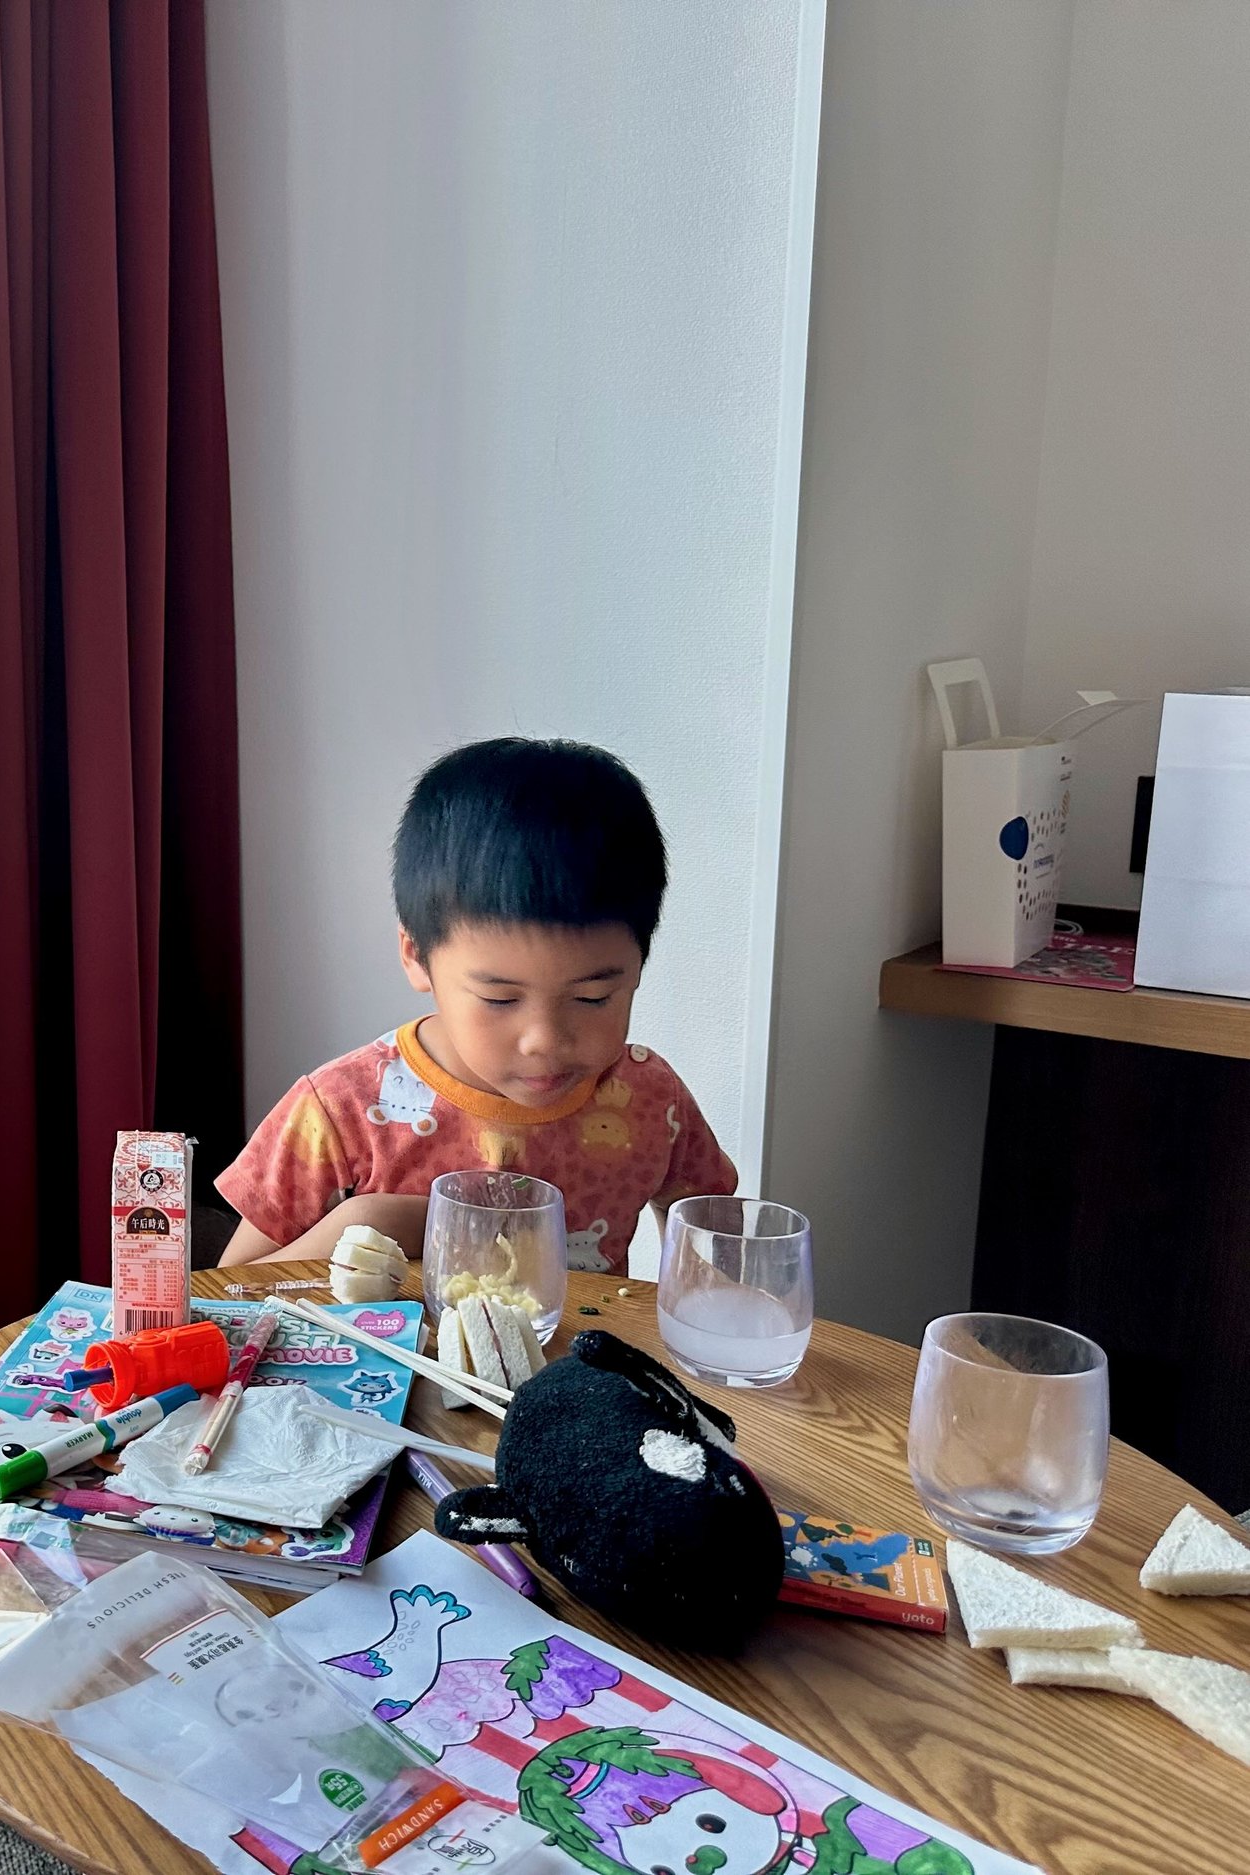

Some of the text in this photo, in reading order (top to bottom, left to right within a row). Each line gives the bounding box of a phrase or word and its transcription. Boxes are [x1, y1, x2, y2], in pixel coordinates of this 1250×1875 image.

[131, 1217, 165, 1230] 午后時光
[80, 1290, 99, 1301] DK
[377, 1318, 400, 1326] 100
[115, 1408, 142, 1425] double
[65, 1430, 94, 1448] MARKER
[893, 1562, 907, 1597] Our Planet
[87, 1587, 152, 1629] DELICIOUS
[902, 1611, 935, 1626] yoto
[378, 1798, 444, 1851] SANDWICH
